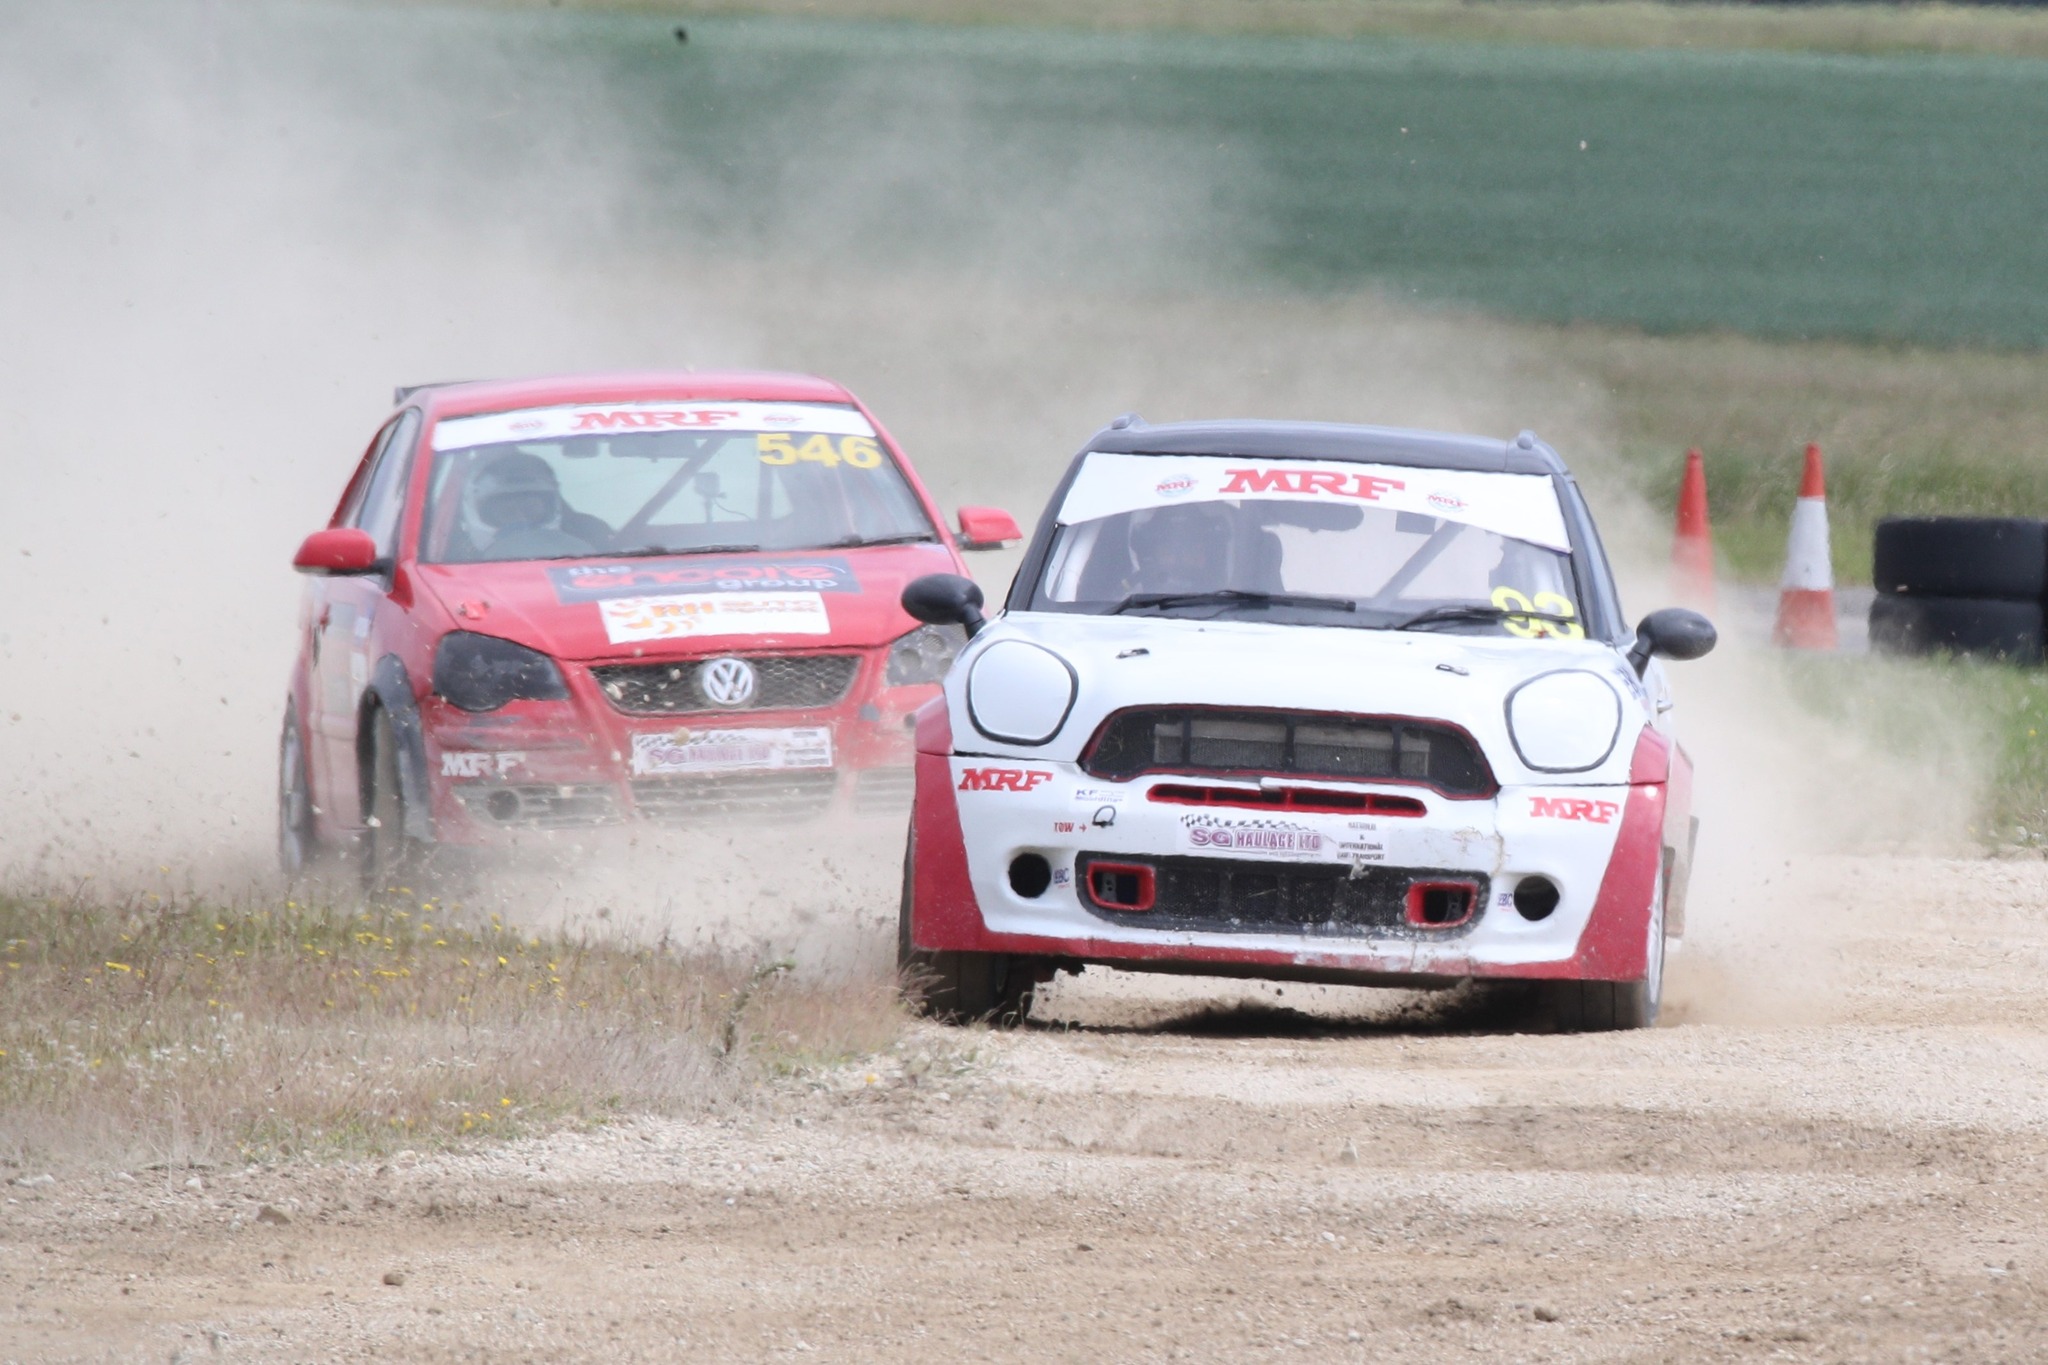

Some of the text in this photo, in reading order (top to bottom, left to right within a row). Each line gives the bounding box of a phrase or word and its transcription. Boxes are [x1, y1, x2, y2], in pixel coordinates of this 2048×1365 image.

[571, 410, 739, 430] MRF
[756, 433, 882, 469] 546
[1154, 479, 1199, 493] MRF
[1219, 469, 1405, 500] MRF
[568, 565, 632, 576] the
[716, 578, 839, 590] group
[441, 752, 526, 777] MRF
[958, 768, 1054, 792] MRF
[1528, 797, 1618, 824] MRF
[1054, 822, 1074, 832] TOW
[1189, 828, 1322, 850] SG HAULAGE LTD
